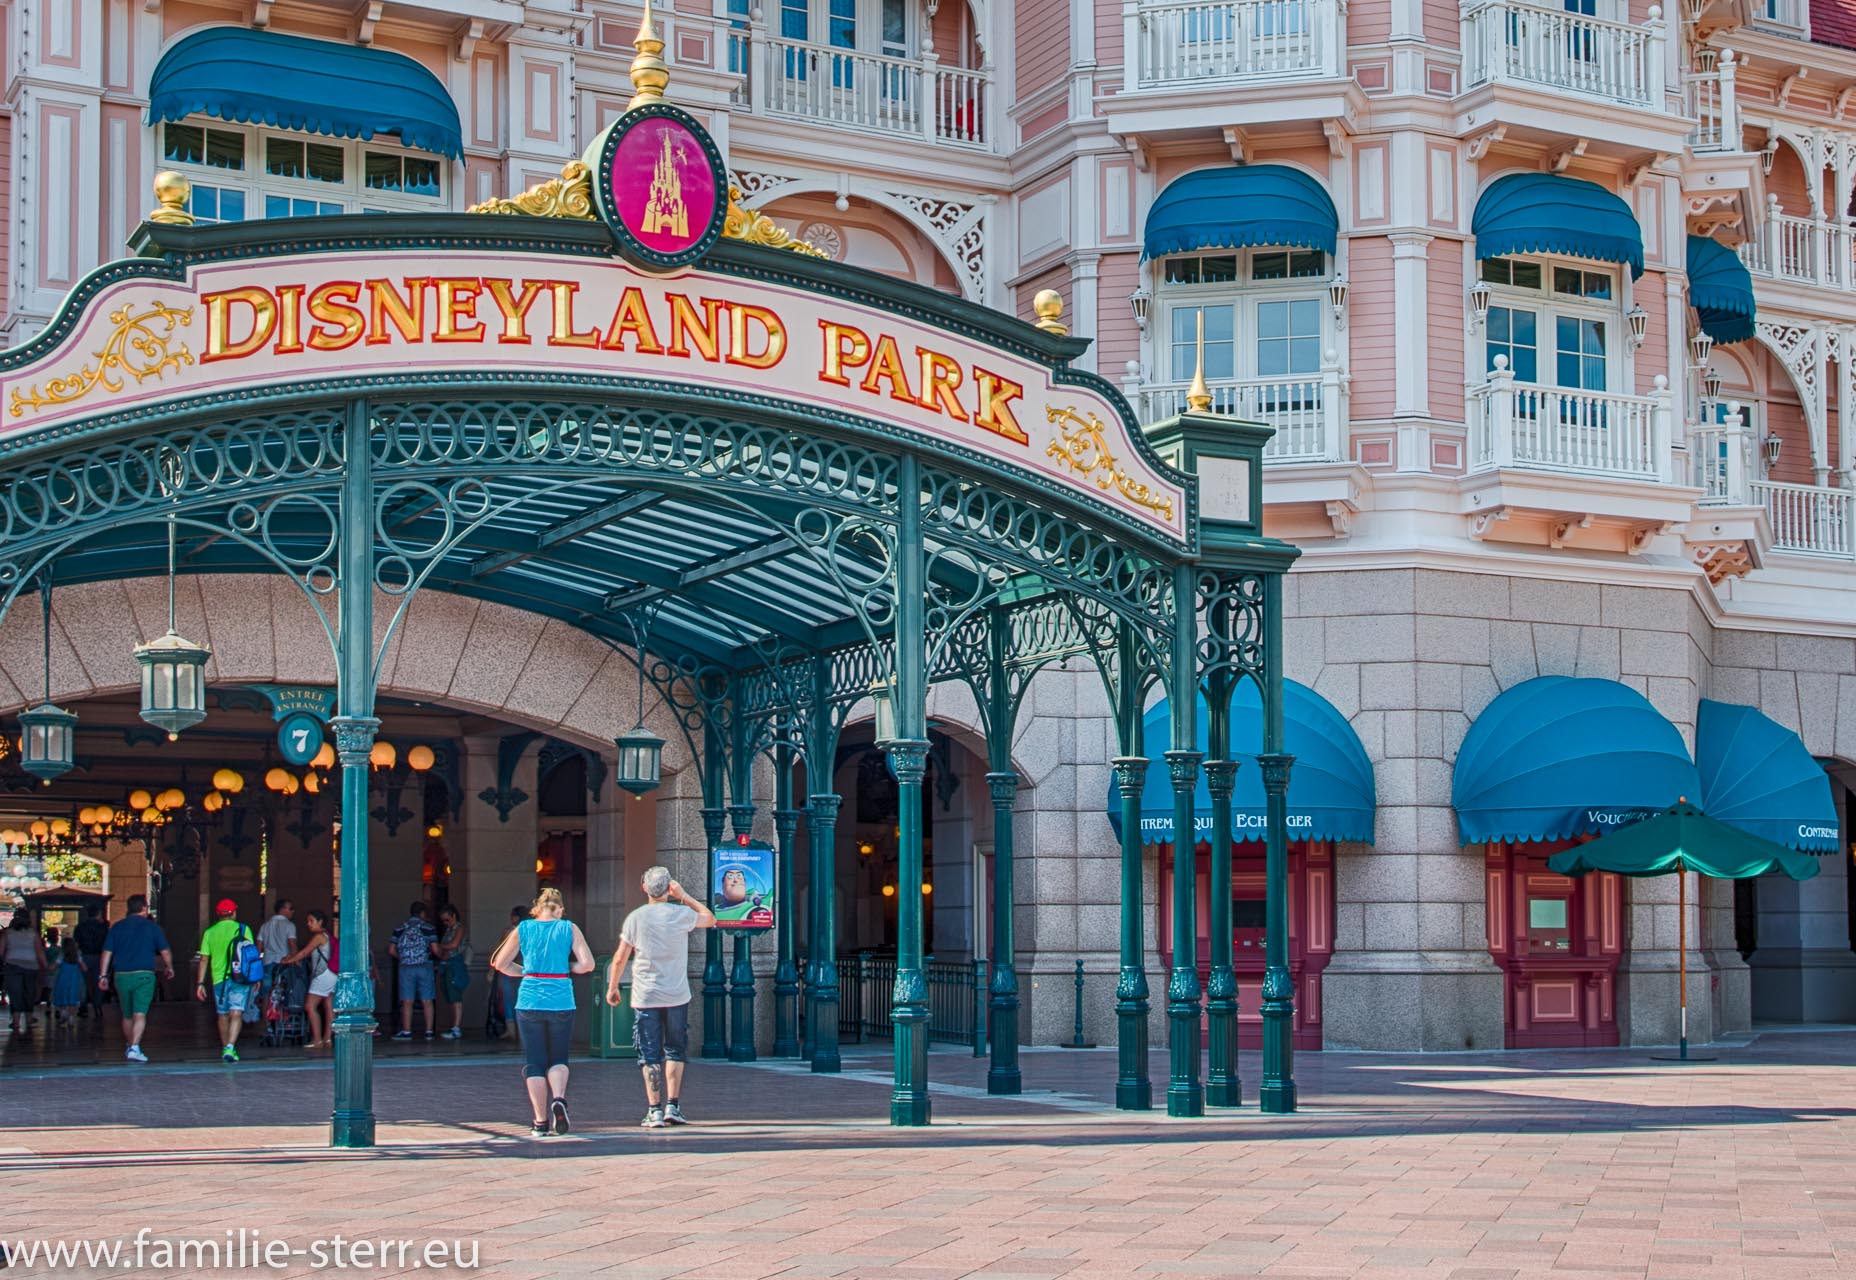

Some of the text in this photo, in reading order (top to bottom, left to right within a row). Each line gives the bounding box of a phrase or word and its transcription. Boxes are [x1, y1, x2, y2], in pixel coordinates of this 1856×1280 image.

[199, 276, 1029, 447] DISNEYLAND PARK
[276, 702, 326, 713] ENTRANCE
[292, 729, 310, 753] 7
